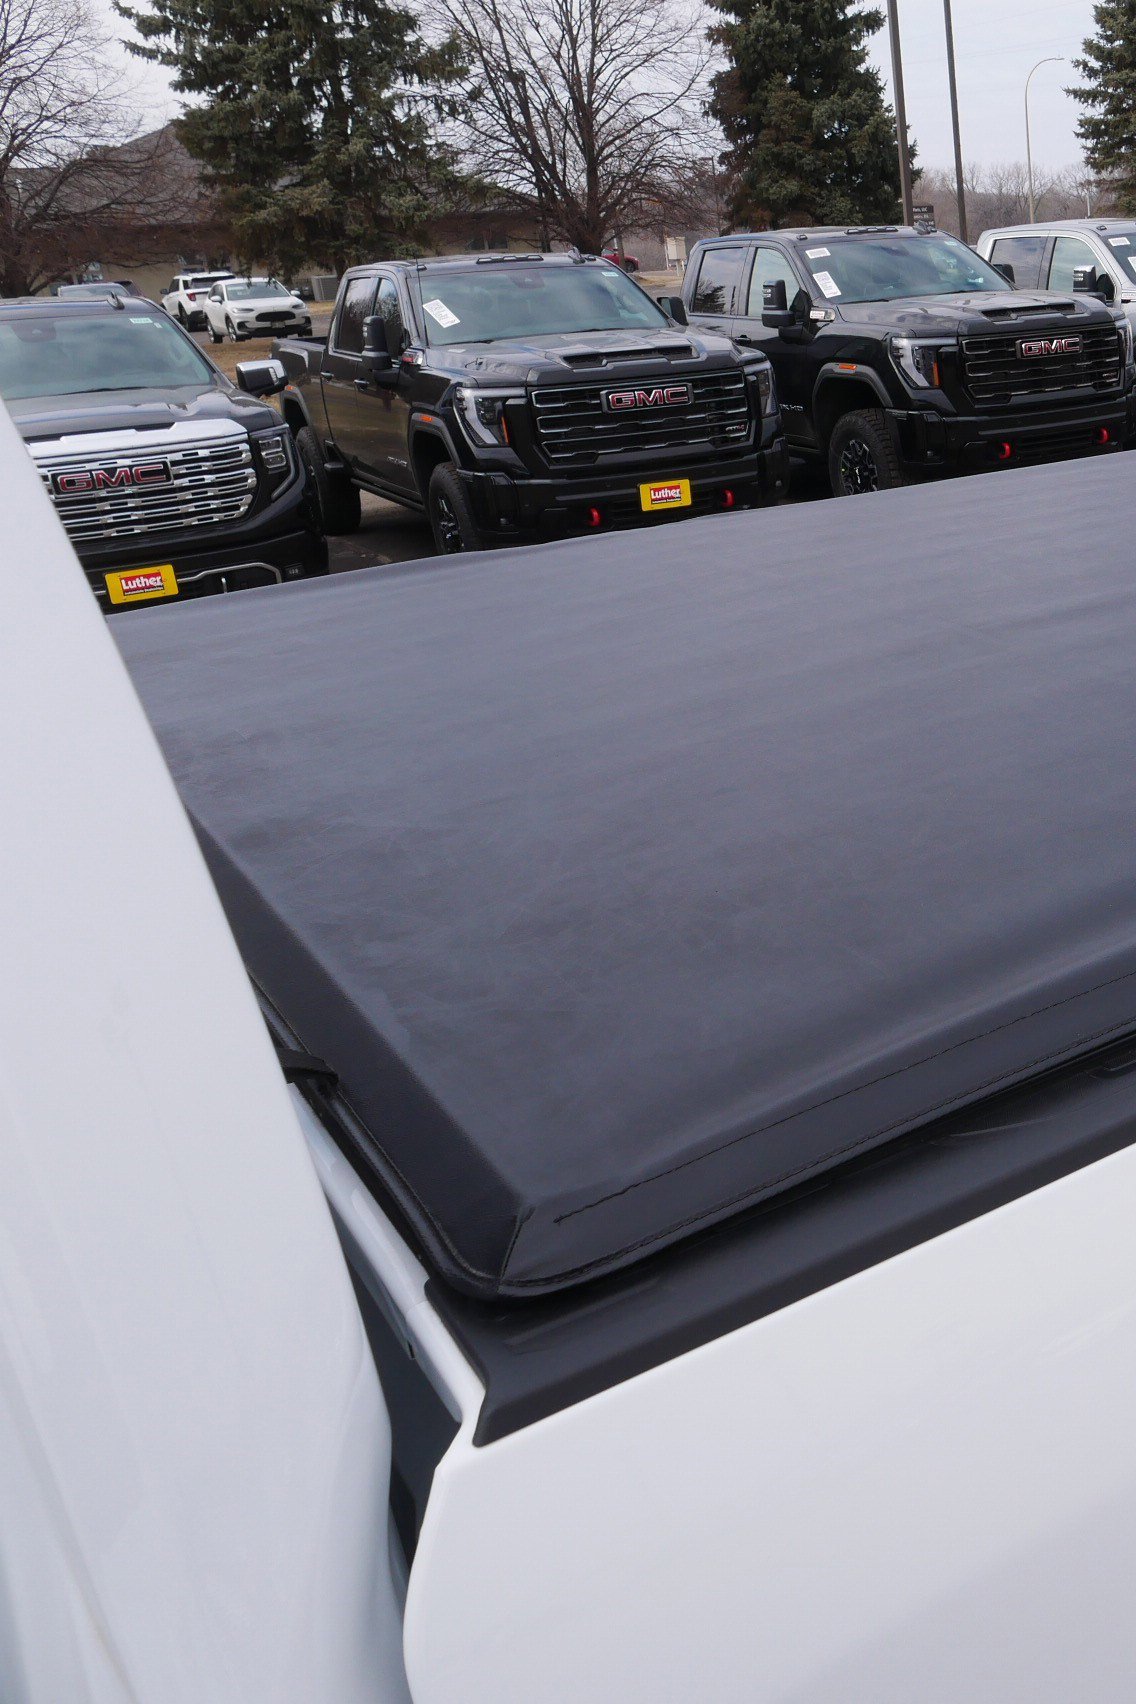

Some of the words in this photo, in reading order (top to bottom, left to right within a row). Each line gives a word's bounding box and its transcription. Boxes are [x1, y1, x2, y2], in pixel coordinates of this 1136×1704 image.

[1022, 338, 1080, 356] GMC
[608, 386, 689, 409] GMC
[58, 464, 167, 492] GMC
[651, 488, 681, 499] Luther
[121, 576, 164, 590] Luther
